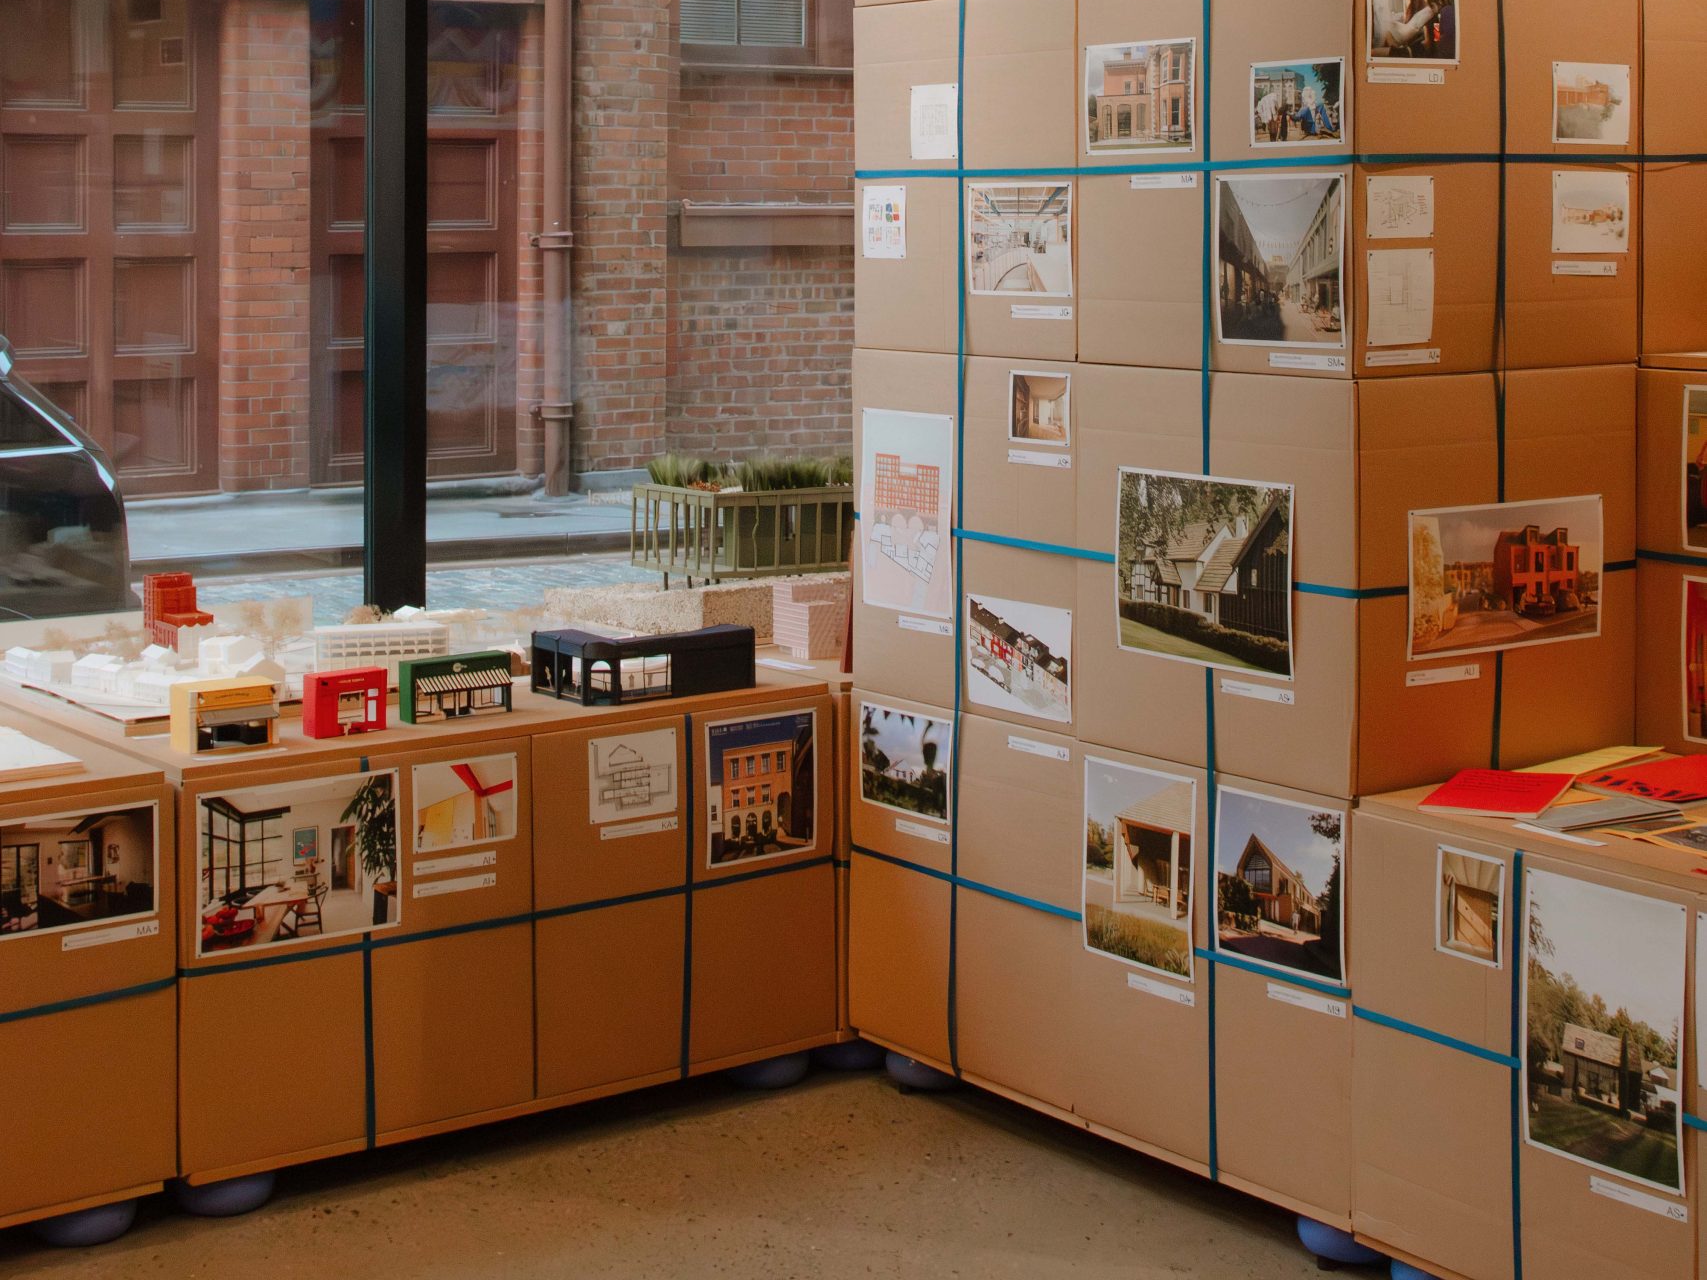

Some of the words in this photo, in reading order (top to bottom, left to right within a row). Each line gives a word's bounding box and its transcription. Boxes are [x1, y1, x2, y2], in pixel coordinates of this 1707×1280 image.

[1327, 357, 1341, 368] SM
[136, 925, 153, 936] MA
[1666, 1206, 1681, 1219] AS
